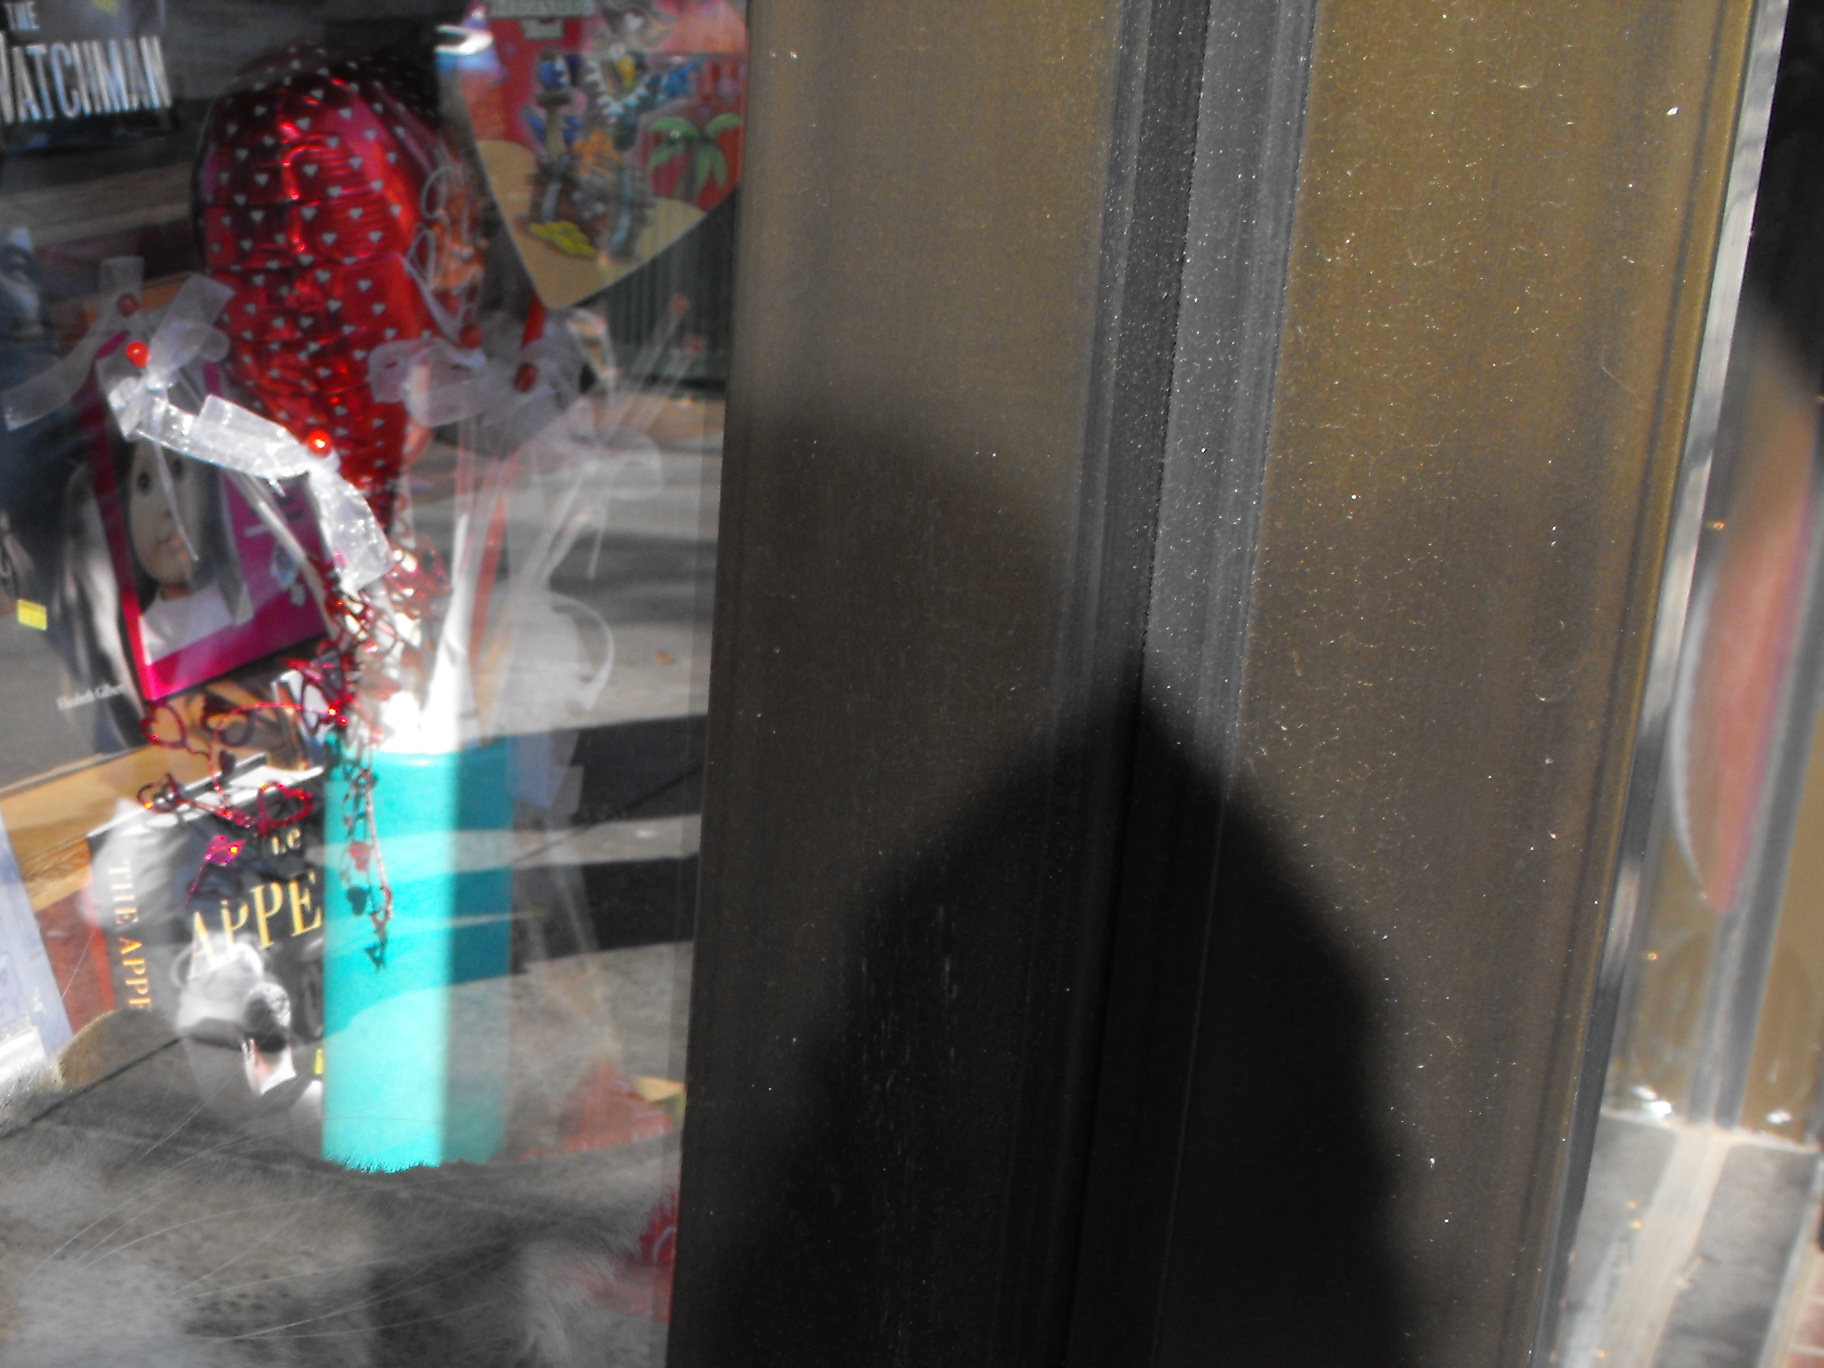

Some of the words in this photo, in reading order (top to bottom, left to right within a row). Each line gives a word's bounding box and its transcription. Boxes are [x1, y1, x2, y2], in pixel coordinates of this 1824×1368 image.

[108, 859, 138, 925] THE
[188, 870, 323, 981] APPE
[119, 936, 152, 1012] APPE
